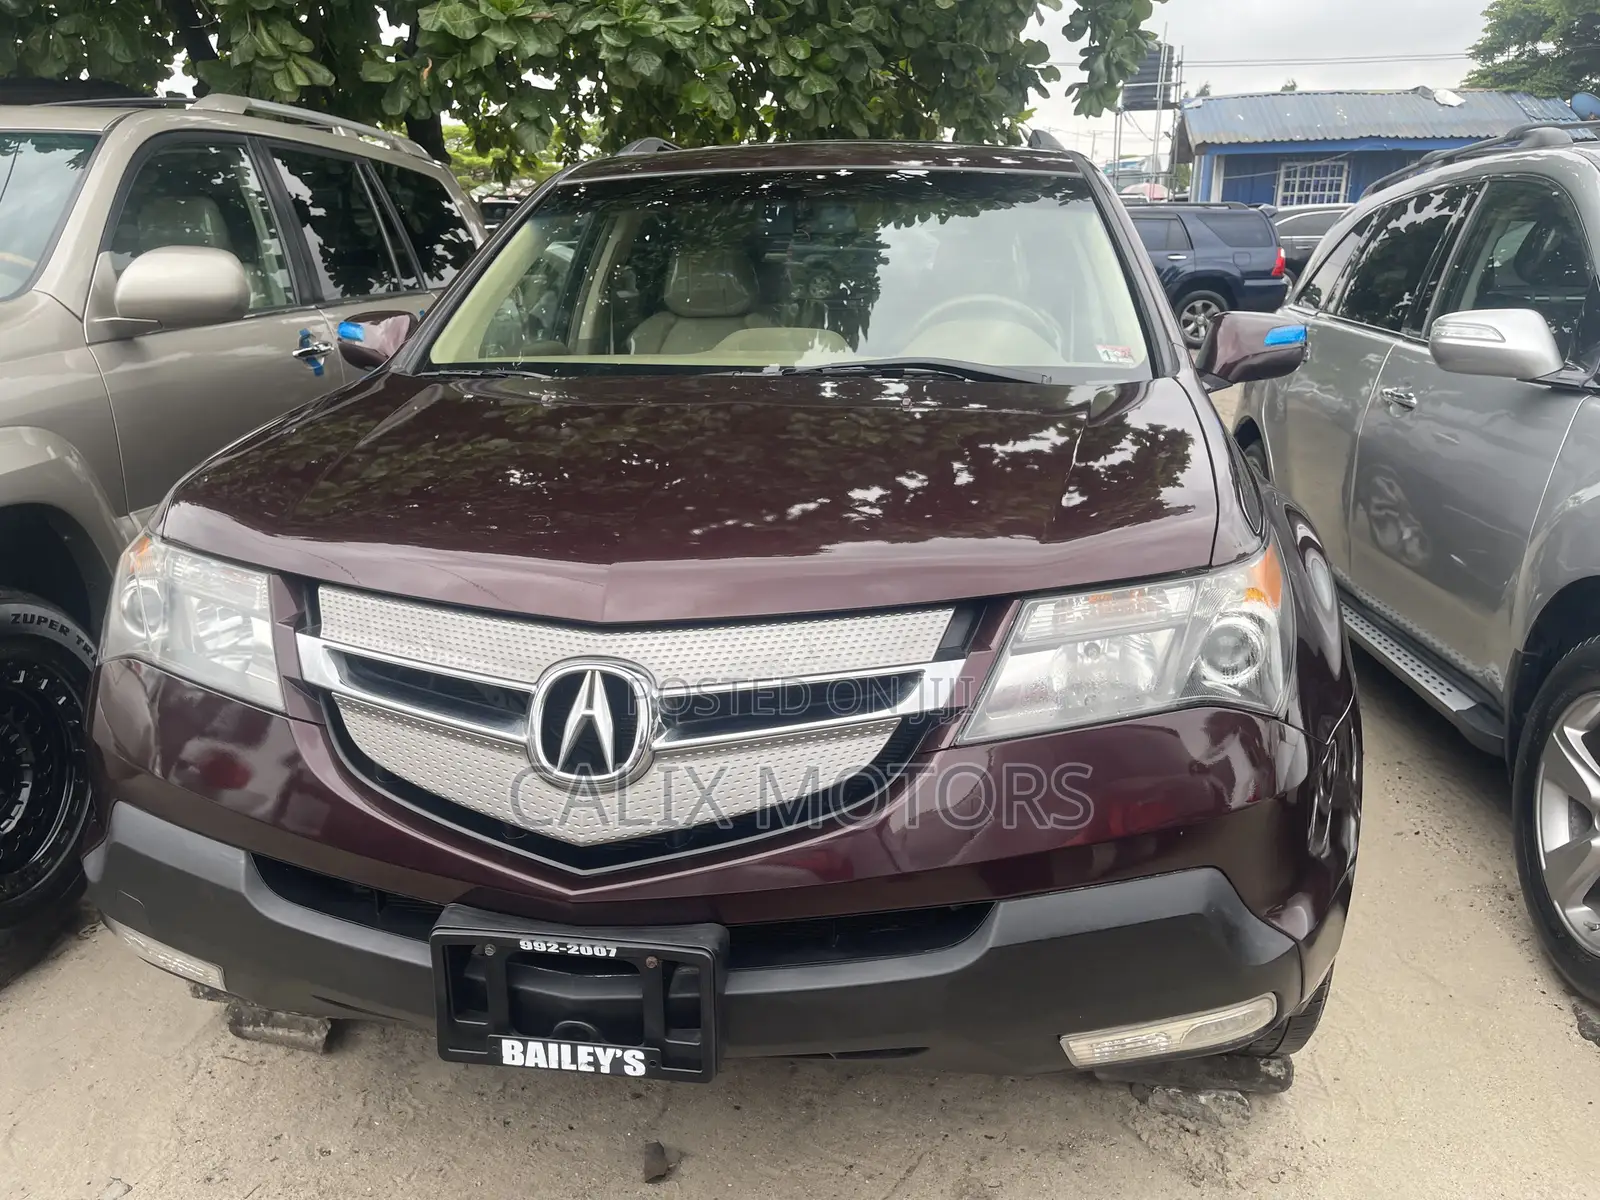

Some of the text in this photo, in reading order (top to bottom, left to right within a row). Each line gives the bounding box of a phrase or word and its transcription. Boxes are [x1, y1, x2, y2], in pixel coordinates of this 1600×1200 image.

[10, 613, 71, 636] ZUPER
[519, 939, 617, 957] 992-2007
[501, 1038, 646, 1077] BAILEY'S
